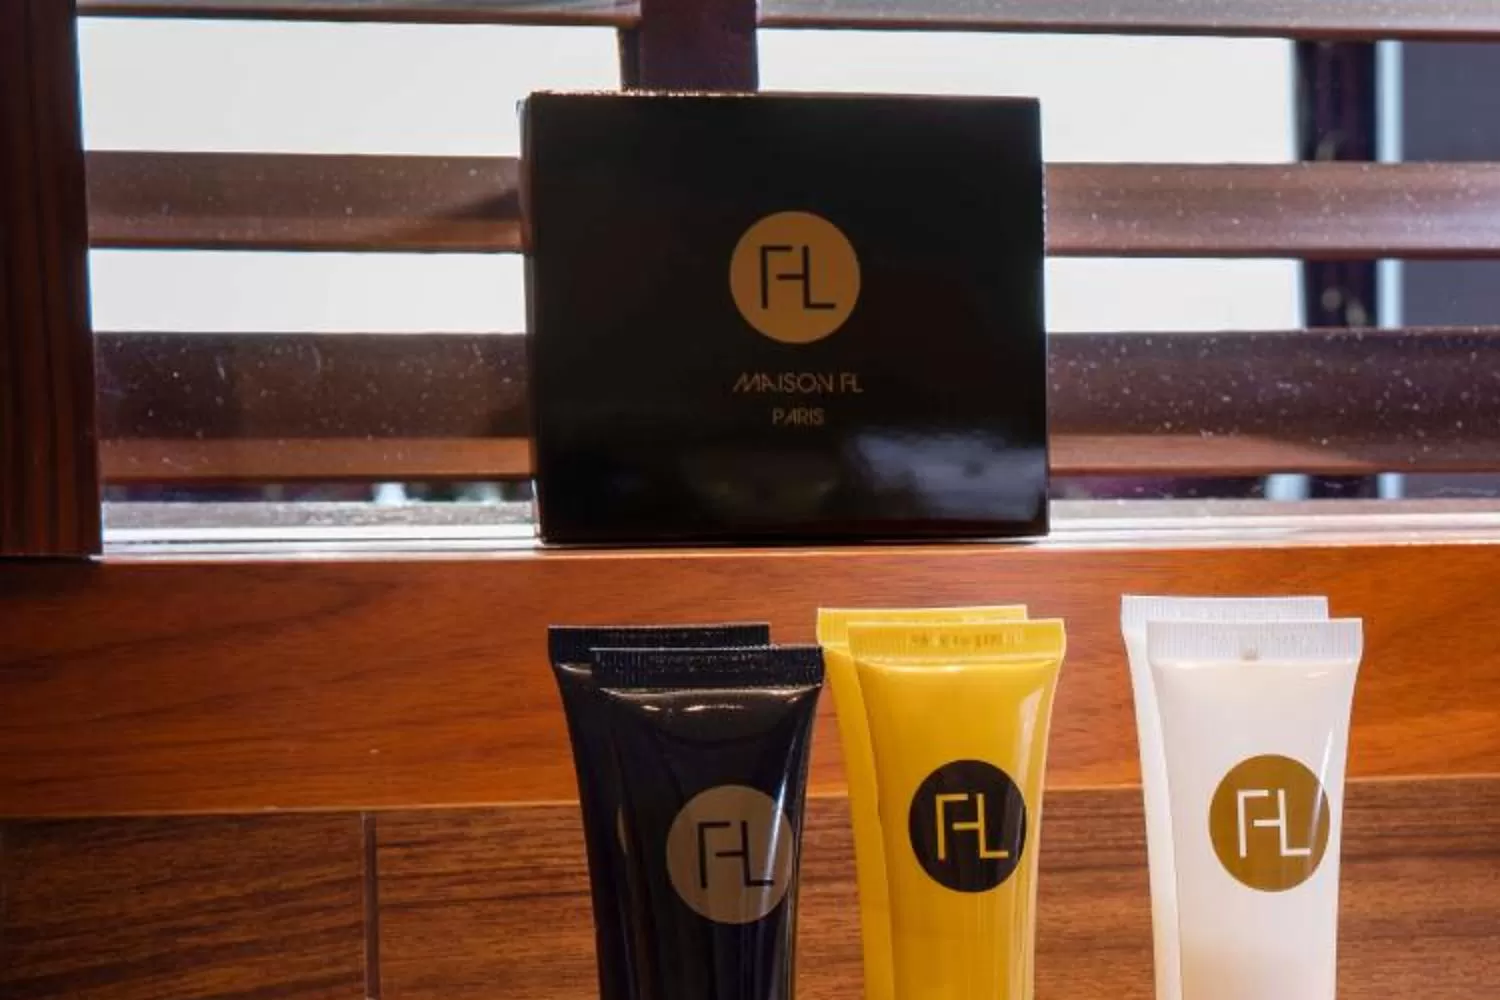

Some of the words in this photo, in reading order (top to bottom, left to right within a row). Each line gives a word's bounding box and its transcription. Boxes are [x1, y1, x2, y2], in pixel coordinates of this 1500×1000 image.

[760, 245, 836, 309] FL
[732, 371, 834, 394] MAISON
[838, 371, 865, 394] FL
[771, 407, 825, 425] PARIS
[698, 820, 774, 889] FL
[936, 793, 1009, 860] FL
[1236, 789, 1311, 857] FL
